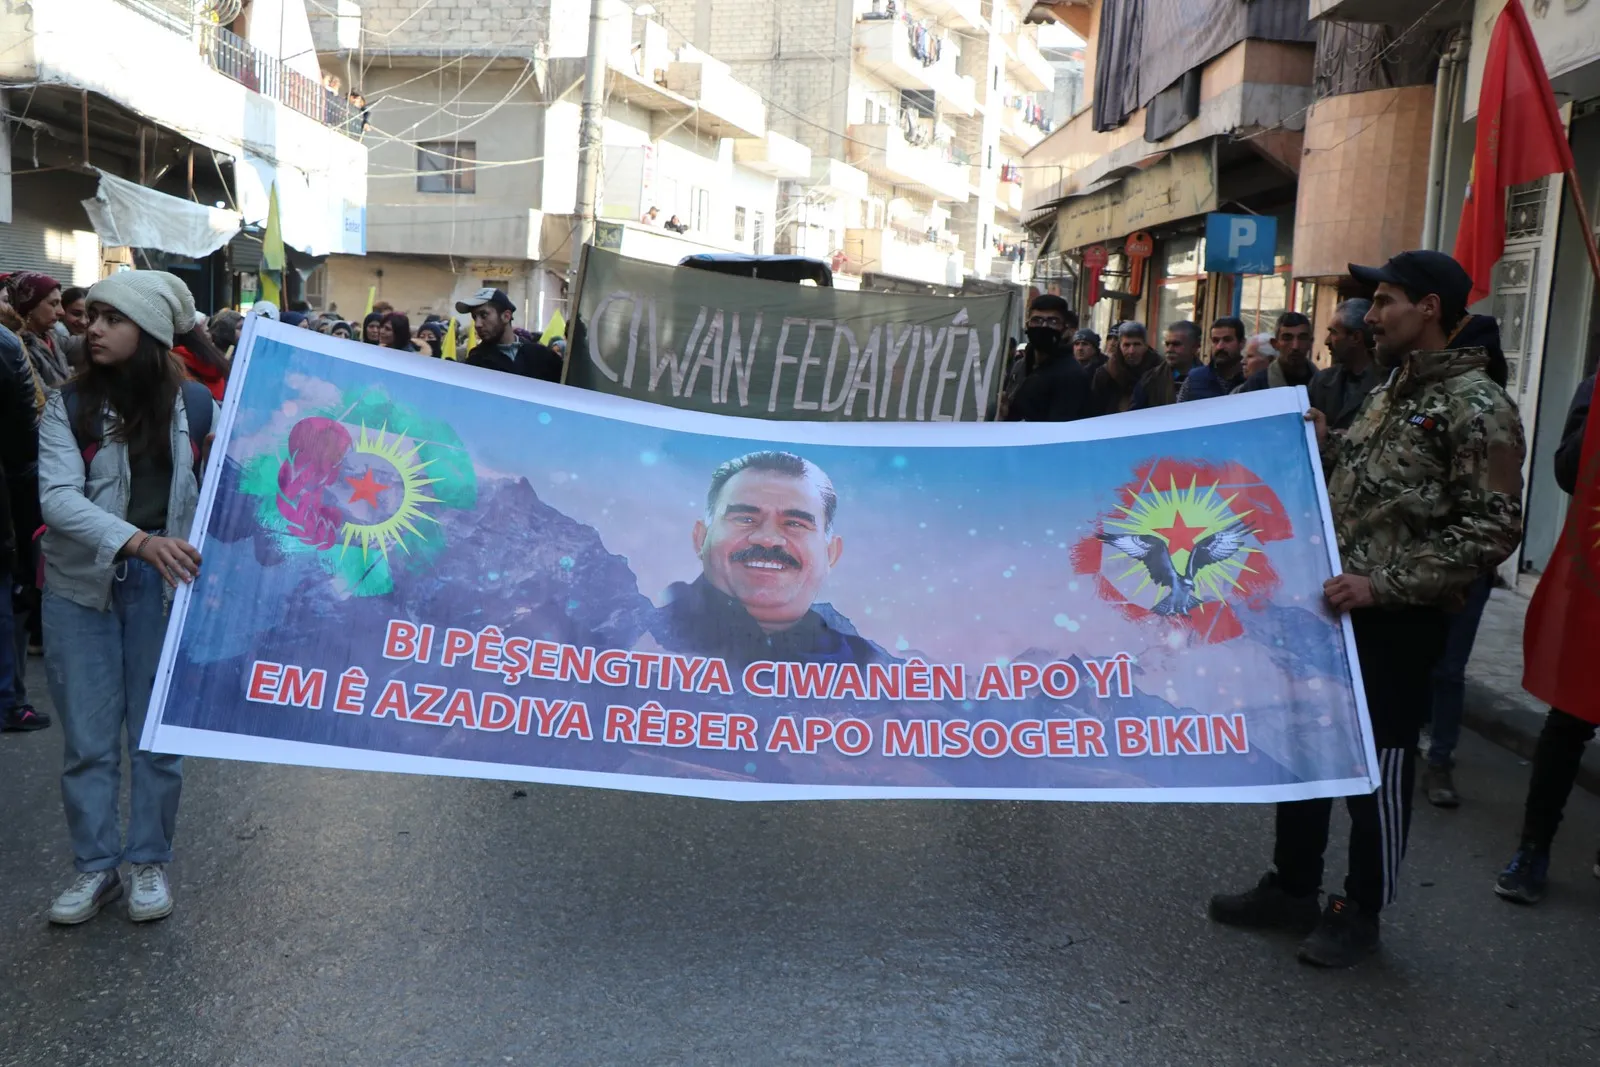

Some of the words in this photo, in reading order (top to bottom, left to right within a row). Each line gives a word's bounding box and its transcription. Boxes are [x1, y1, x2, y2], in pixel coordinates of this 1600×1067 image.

[1228, 218, 1257, 258] P
[588, 291, 762, 406] CIWAN
[384, 620, 434, 662] BI
[443, 625, 732, 694] PÊŞENGTIYA
[742, 655, 966, 700] CIWANÊN
[976, 661, 1078, 700] APO
[1086, 651, 1133, 697] YÎ
[247, 661, 326, 709] EM
[334, 667, 369, 714] Ê
[372, 681, 593, 740] AZADIYA
[605, 701, 757, 750] RÊBER
[766, 716, 873, 756] APO
[882, 719, 1108, 758] MISOGER
[1116, 714, 1249, 756] BIKIN
